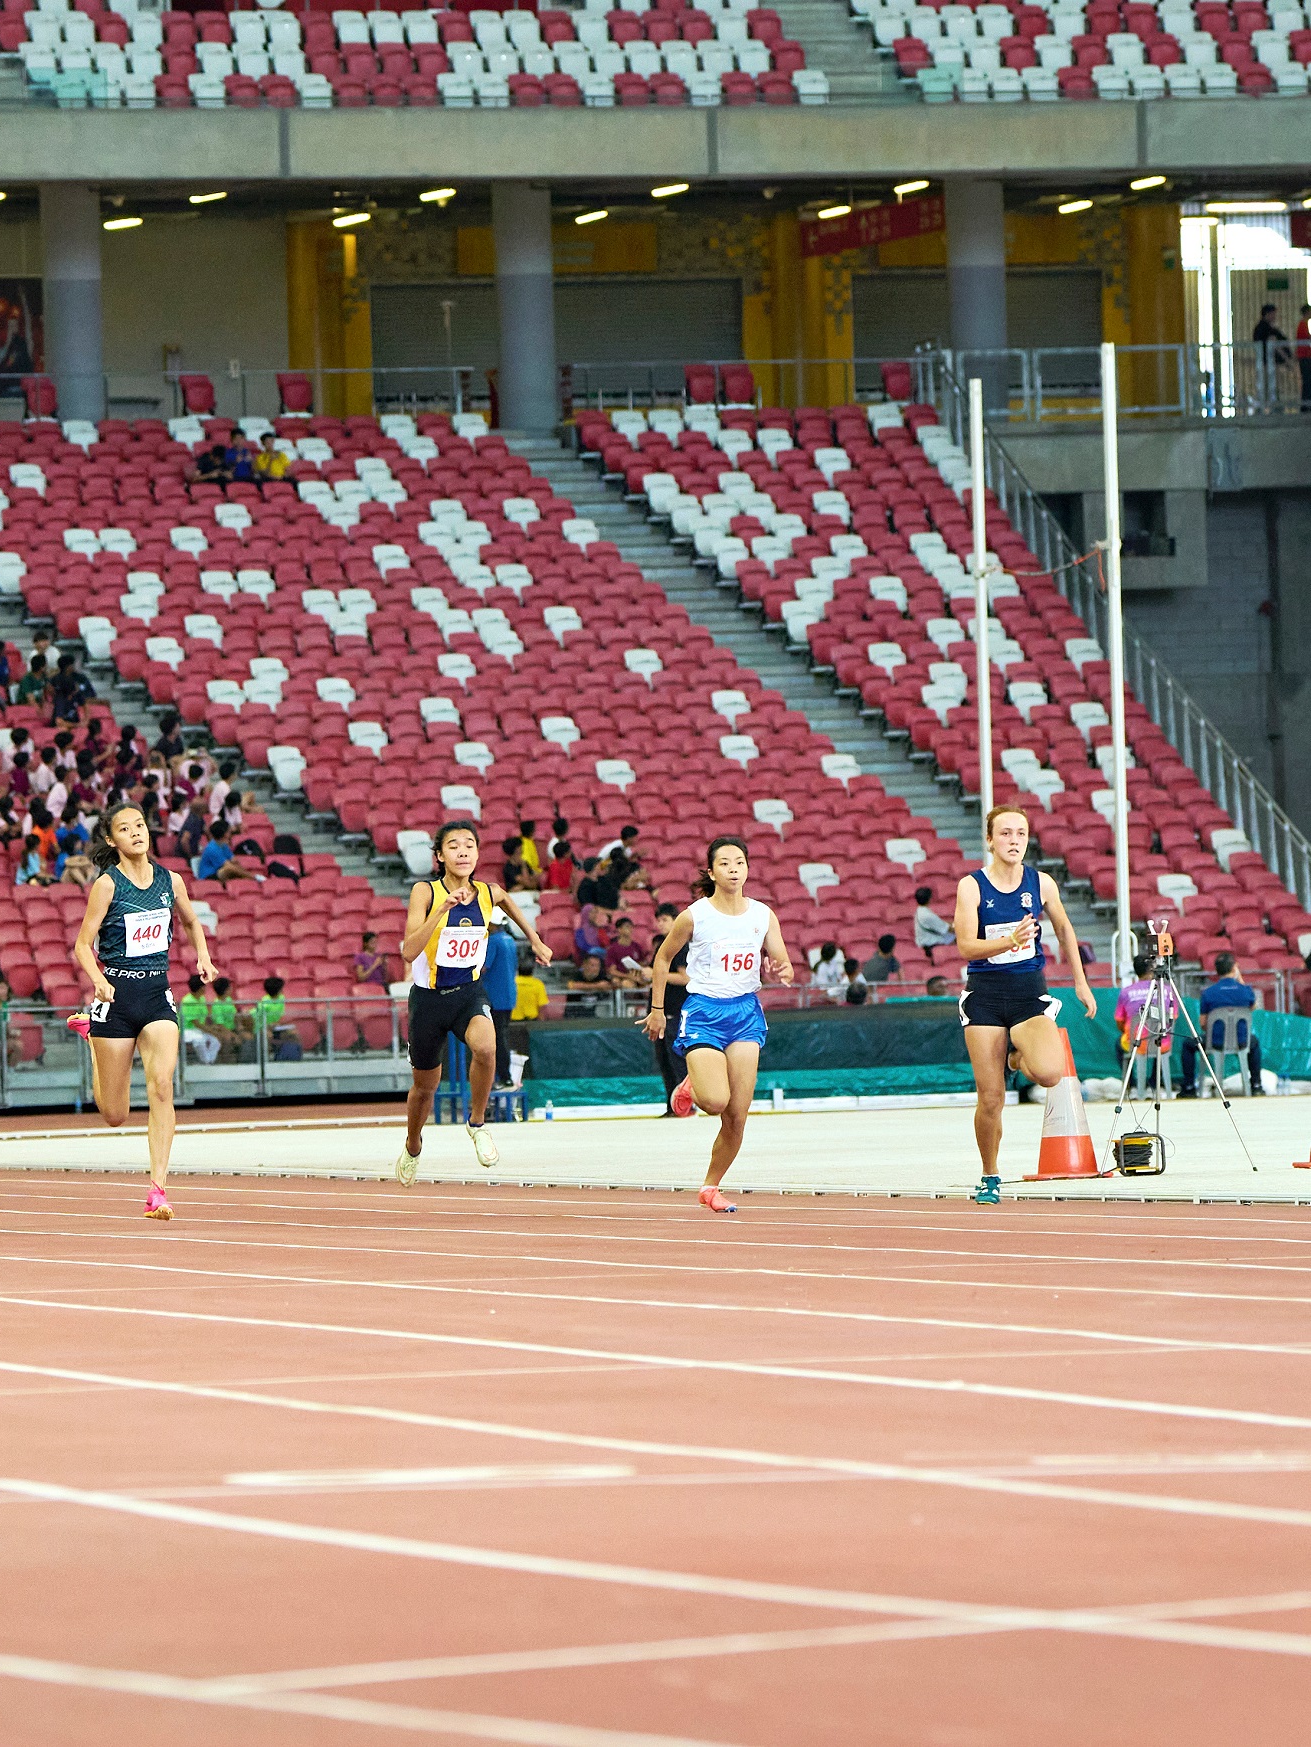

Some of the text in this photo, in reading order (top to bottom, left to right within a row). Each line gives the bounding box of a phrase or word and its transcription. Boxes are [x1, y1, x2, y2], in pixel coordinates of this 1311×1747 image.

[132, 924, 161, 943] 440
[447, 939, 479, 958] 309
[721, 953, 754, 972] 156
[118, 970, 146, 979] PRO
